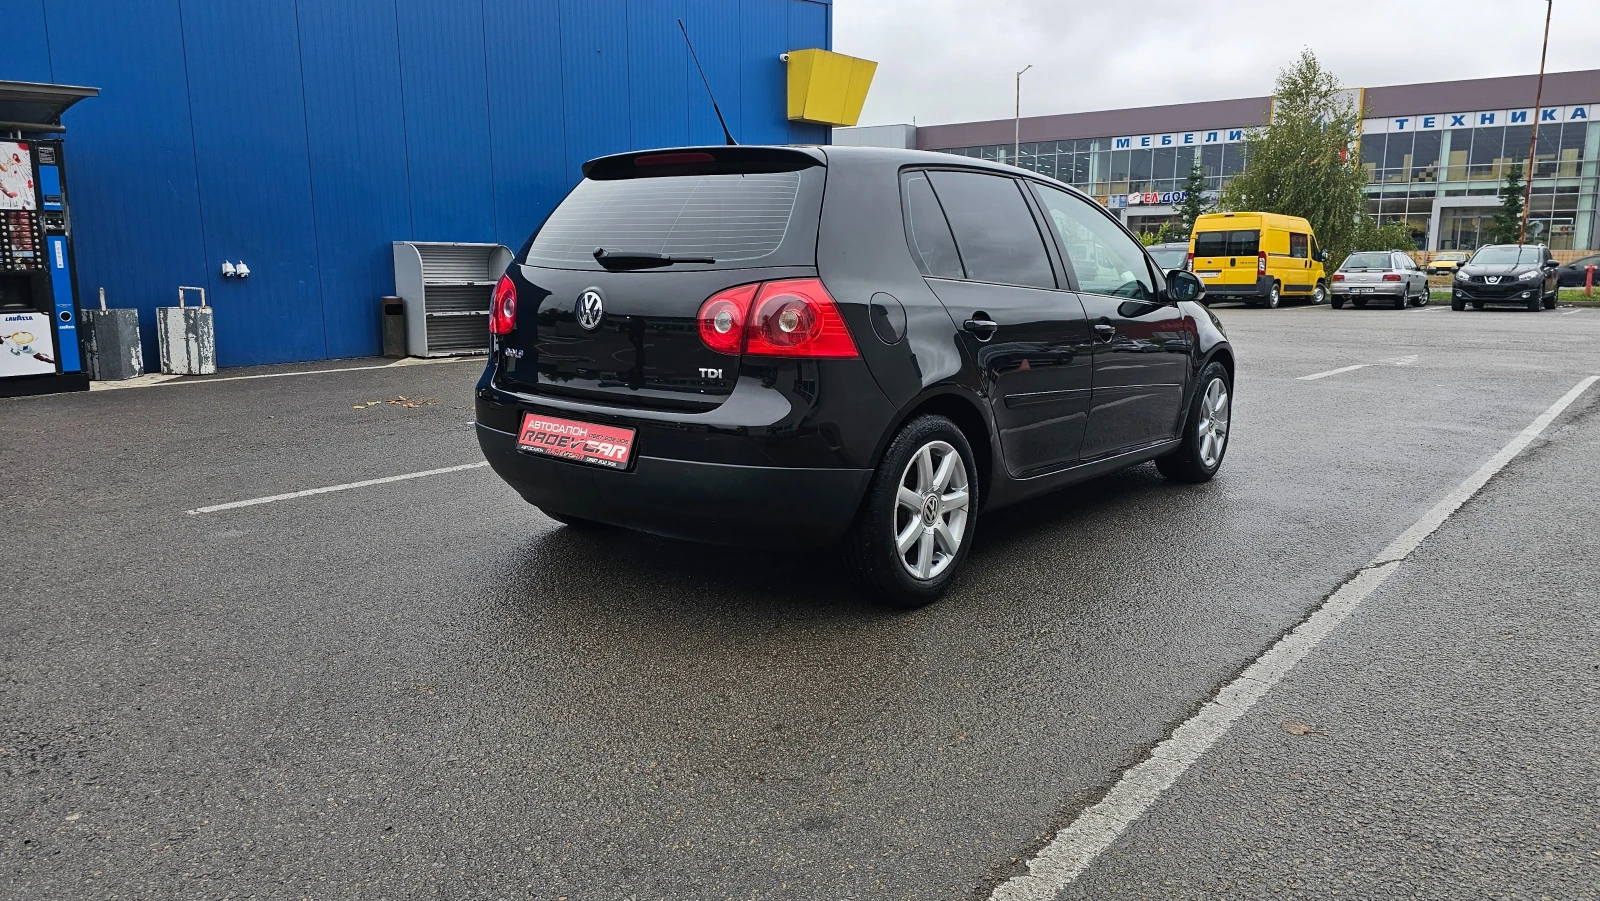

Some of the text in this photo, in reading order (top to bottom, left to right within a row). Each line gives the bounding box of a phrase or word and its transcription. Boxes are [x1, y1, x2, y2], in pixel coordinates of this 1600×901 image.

[1395, 107, 1587, 130] ТЕХНИКА
[1116, 130, 1242, 148] МЕБЕЛИ
[699, 367, 722, 379] TDI
[528, 420, 588, 437] АВТОСАЛОН
